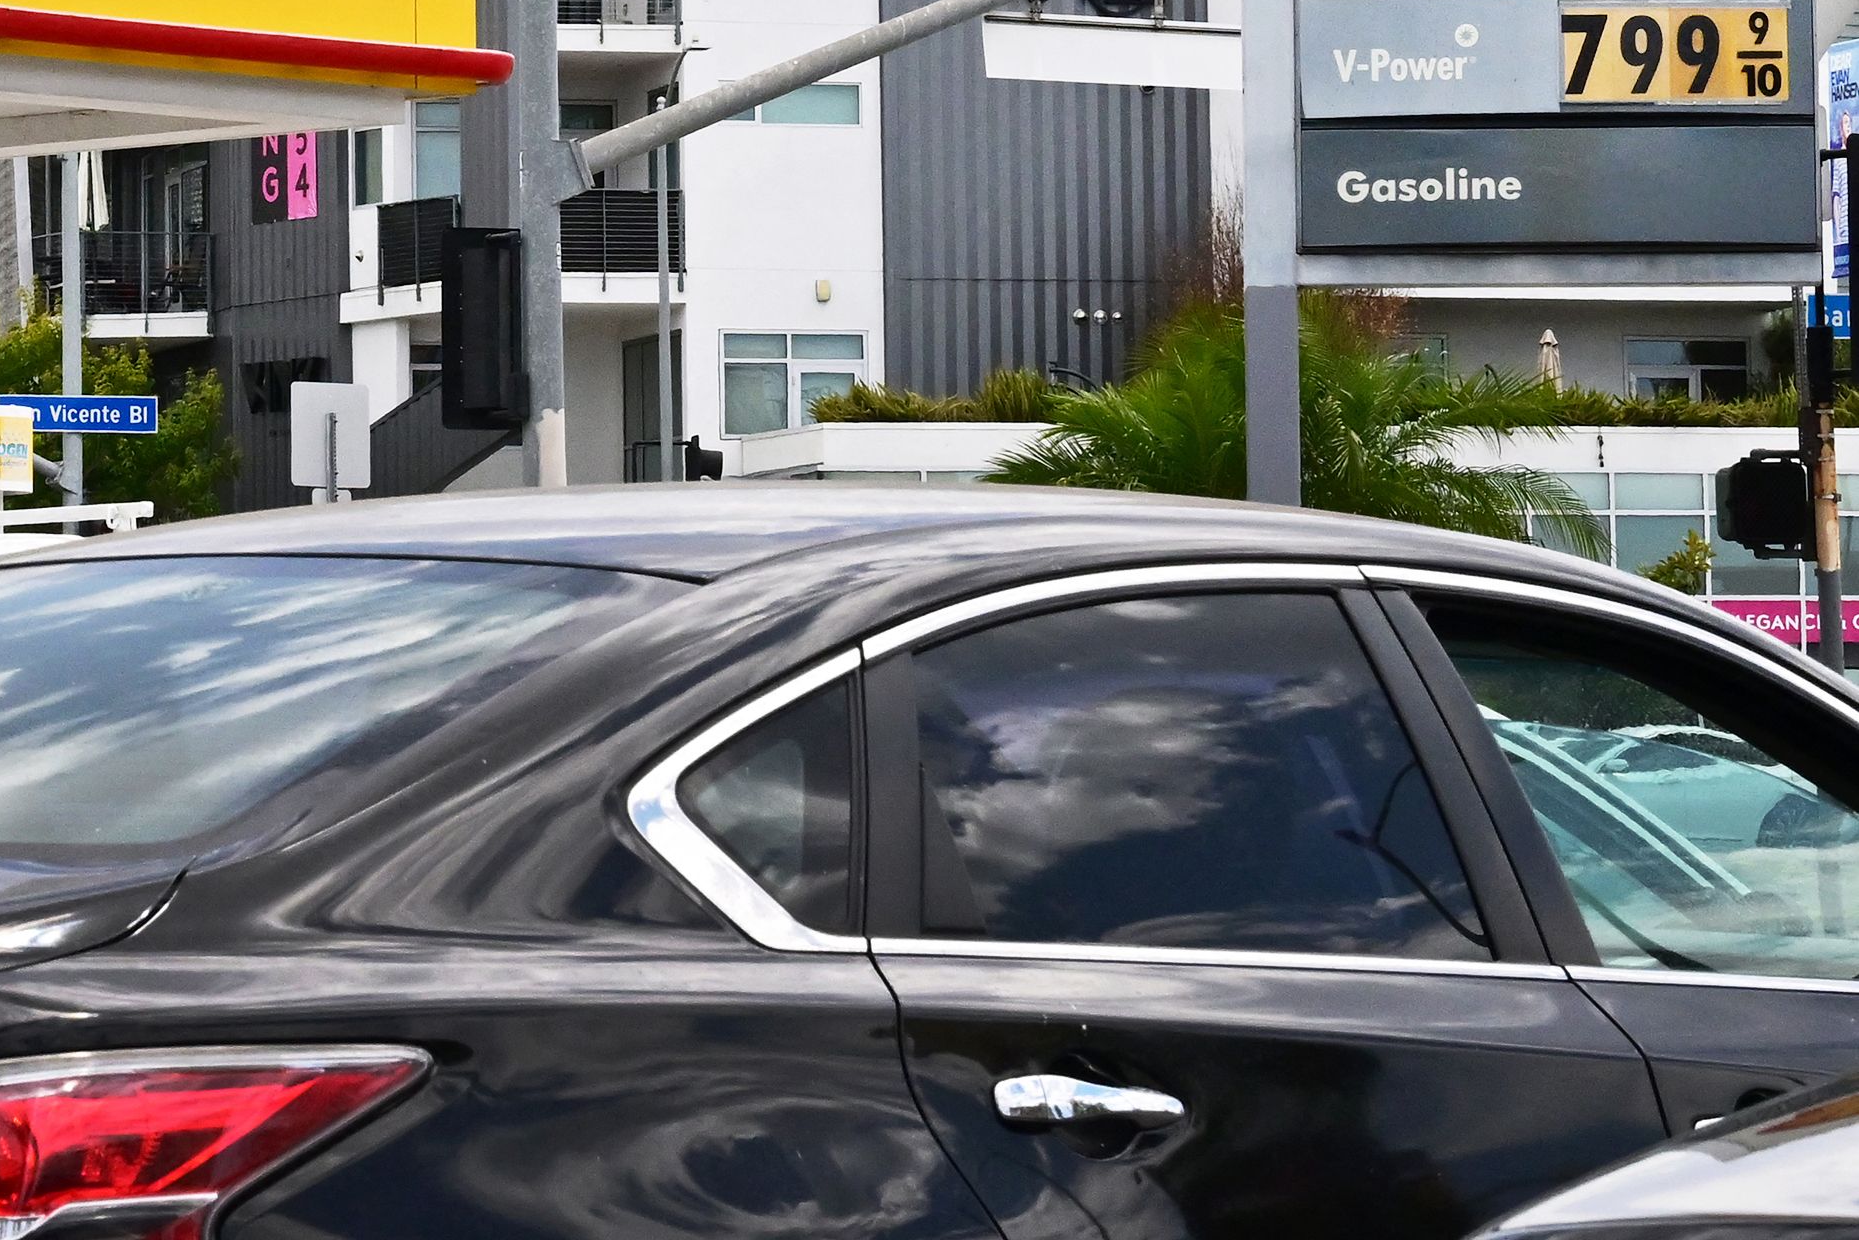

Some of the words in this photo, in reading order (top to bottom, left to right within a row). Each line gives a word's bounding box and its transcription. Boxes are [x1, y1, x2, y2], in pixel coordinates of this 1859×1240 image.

[1749, 11, 1770, 45] 9
[1333, 49, 1469, 83] V-Power
[1561, 14, 1720, 96] 799
[1741, 64, 1782, 97] 10
[1831, 68, 1850, 87] EVAN
[1337, 167, 1523, 204] Gasoline
[50, 405, 121, 425] Vicente
